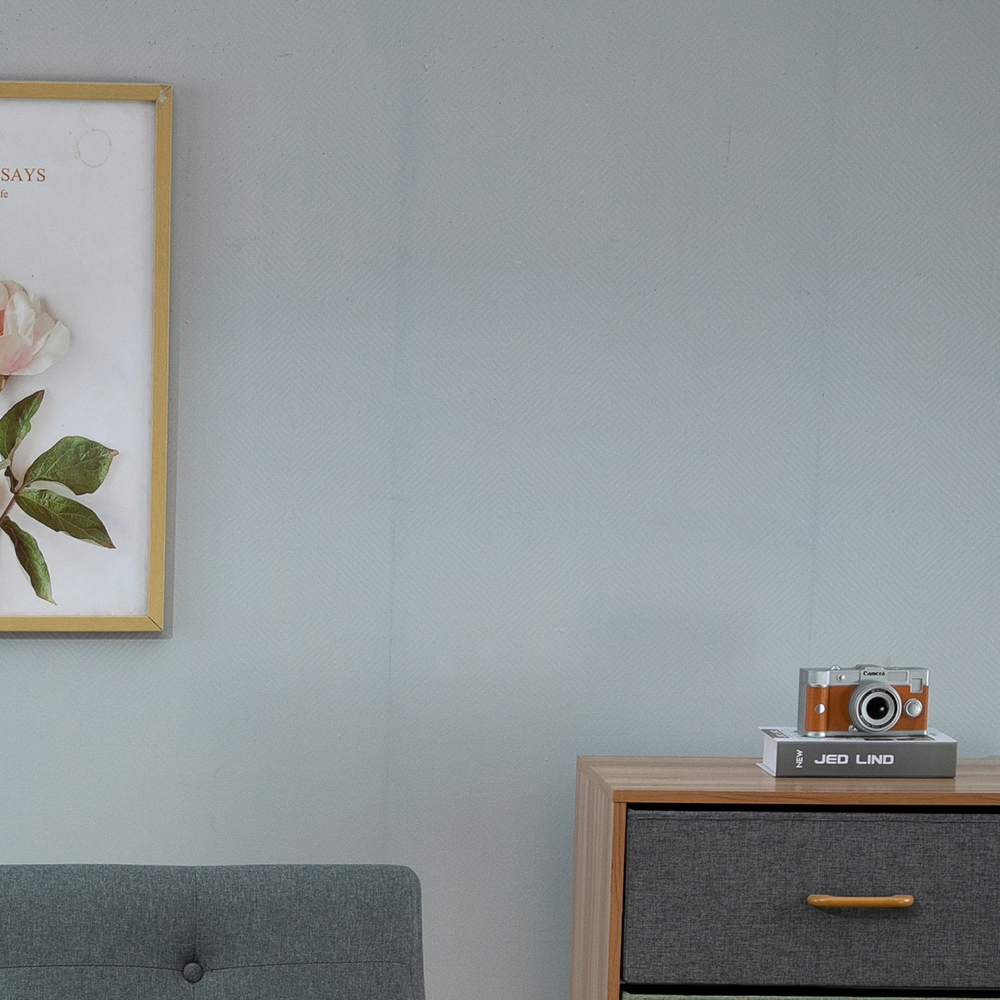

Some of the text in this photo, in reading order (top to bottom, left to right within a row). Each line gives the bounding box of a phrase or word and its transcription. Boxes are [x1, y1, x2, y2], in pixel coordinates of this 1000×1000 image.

[1, 167, 47, 182] SAYS
[796, 749, 804, 769] NEW
[814, 754, 894, 765] JED LIND
